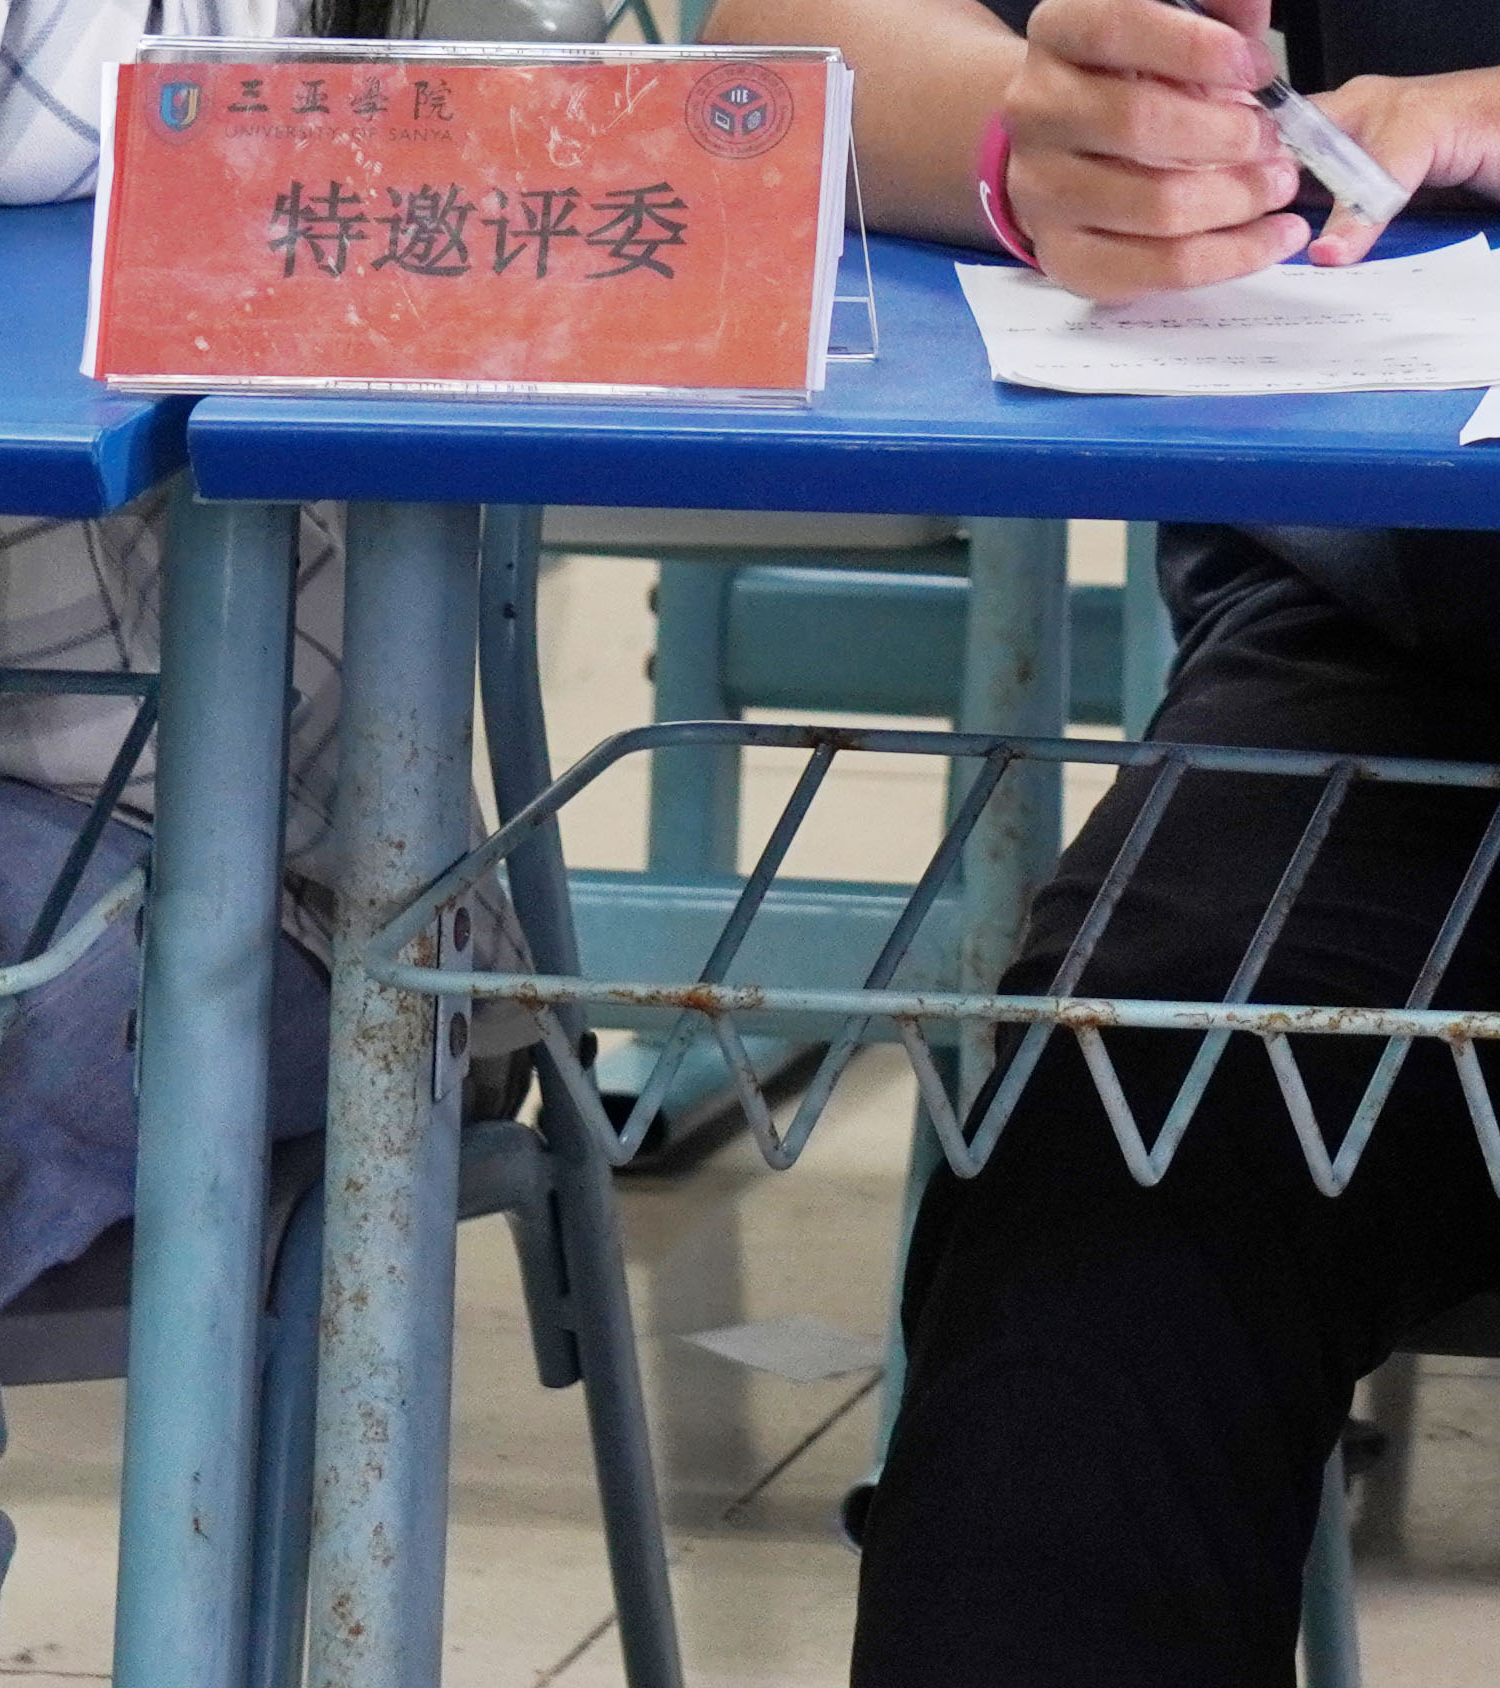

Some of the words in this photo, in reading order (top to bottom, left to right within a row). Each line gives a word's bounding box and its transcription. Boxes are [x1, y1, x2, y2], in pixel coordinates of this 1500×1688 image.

[224, 125, 337, 141] UNIVERSITY
[350, 125, 377, 141] OF
[388, 126, 453, 142] SANYA
[267, 180, 689, 279] 特邀评委
